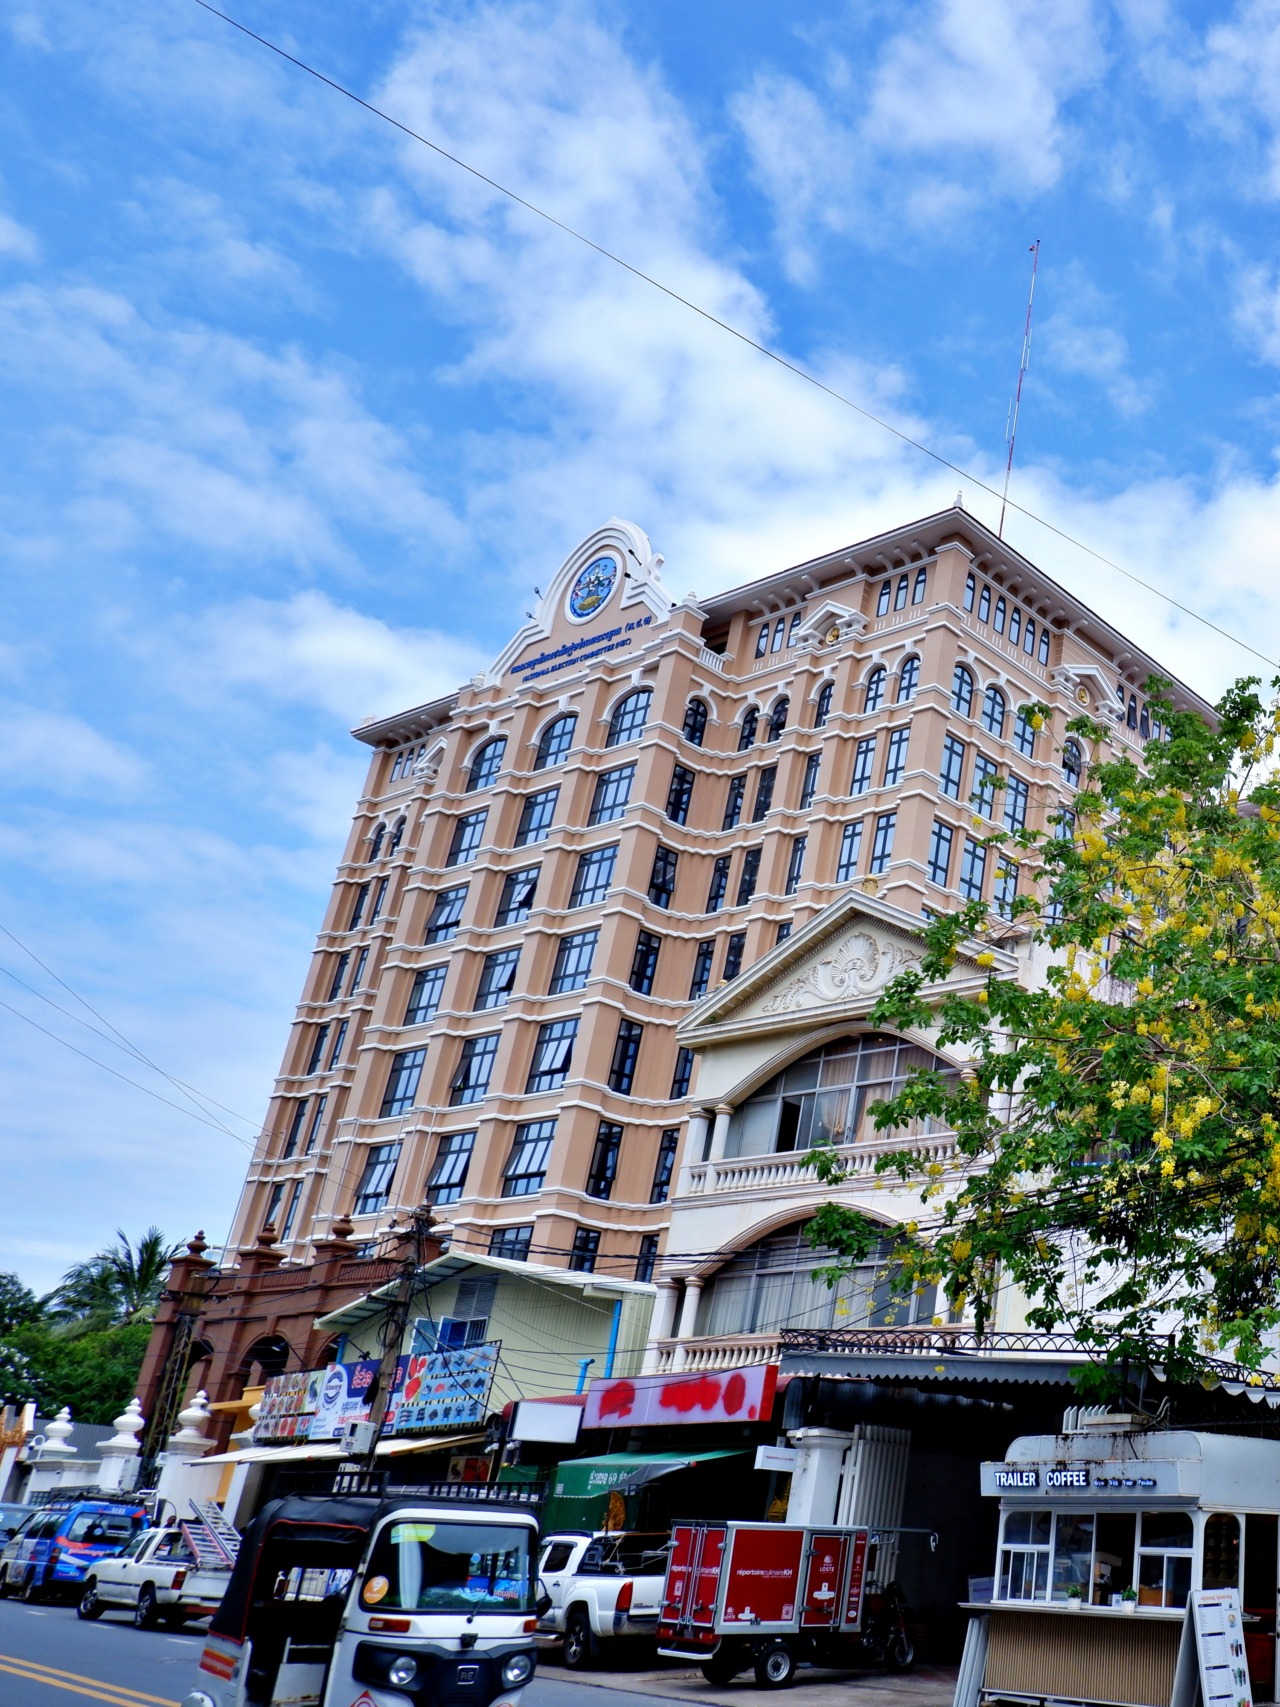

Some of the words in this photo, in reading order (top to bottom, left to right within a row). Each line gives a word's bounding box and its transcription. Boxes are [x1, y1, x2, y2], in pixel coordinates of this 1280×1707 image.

[522, 667, 550, 683] NATIONAL
[550, 656, 579, 673] ELECTION
[580, 643, 615, 662] COMMITTEE
[608, 1472, 618, 1485] 69
[994, 1471, 1037, 1486] TRAILER
[1046, 1471, 1087, 1486] COFFEE
[461, 1671, 474, 1681] RE
